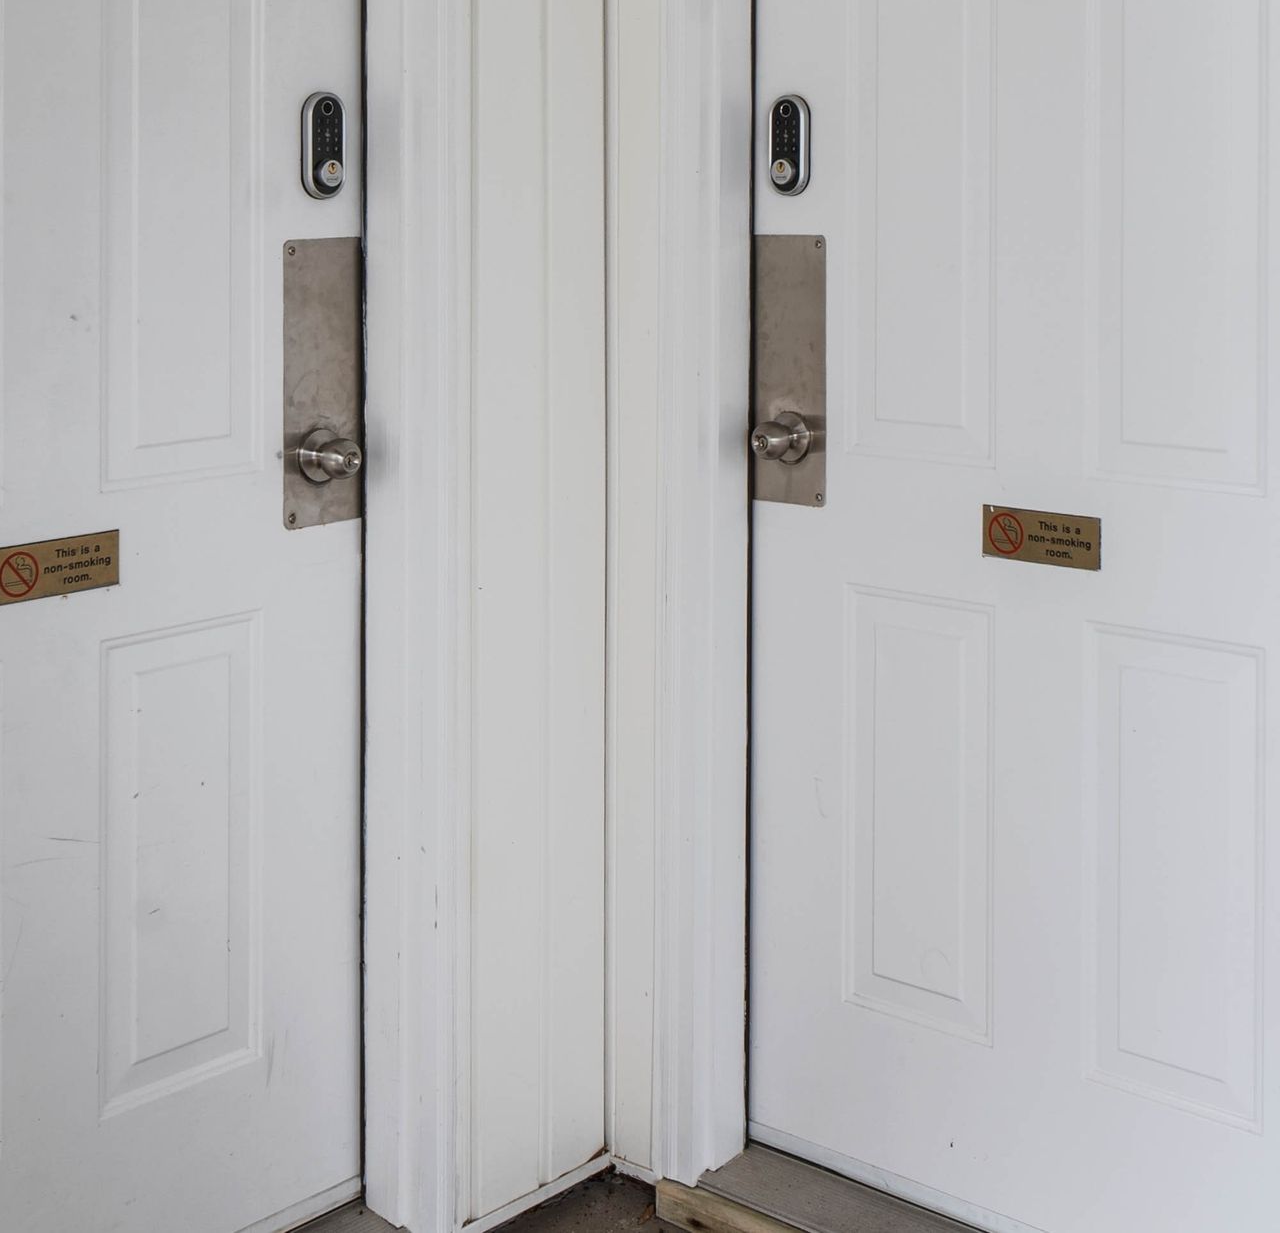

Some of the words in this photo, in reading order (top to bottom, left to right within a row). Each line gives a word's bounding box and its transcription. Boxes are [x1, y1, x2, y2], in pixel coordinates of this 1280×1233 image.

[1038, 521, 1058, 532] This
[1062, 524, 1071, 533] is
[1074, 527, 1081, 535] a
[1027, 534, 1091, 550] non-smoking
[55, 548, 77, 558] This
[80, 545, 90, 554] is
[94, 544, 100, 552] a
[1045, 548, 1073, 559] room.
[43, 556, 111, 575] non-smoking
[63, 575, 93, 585] room.
